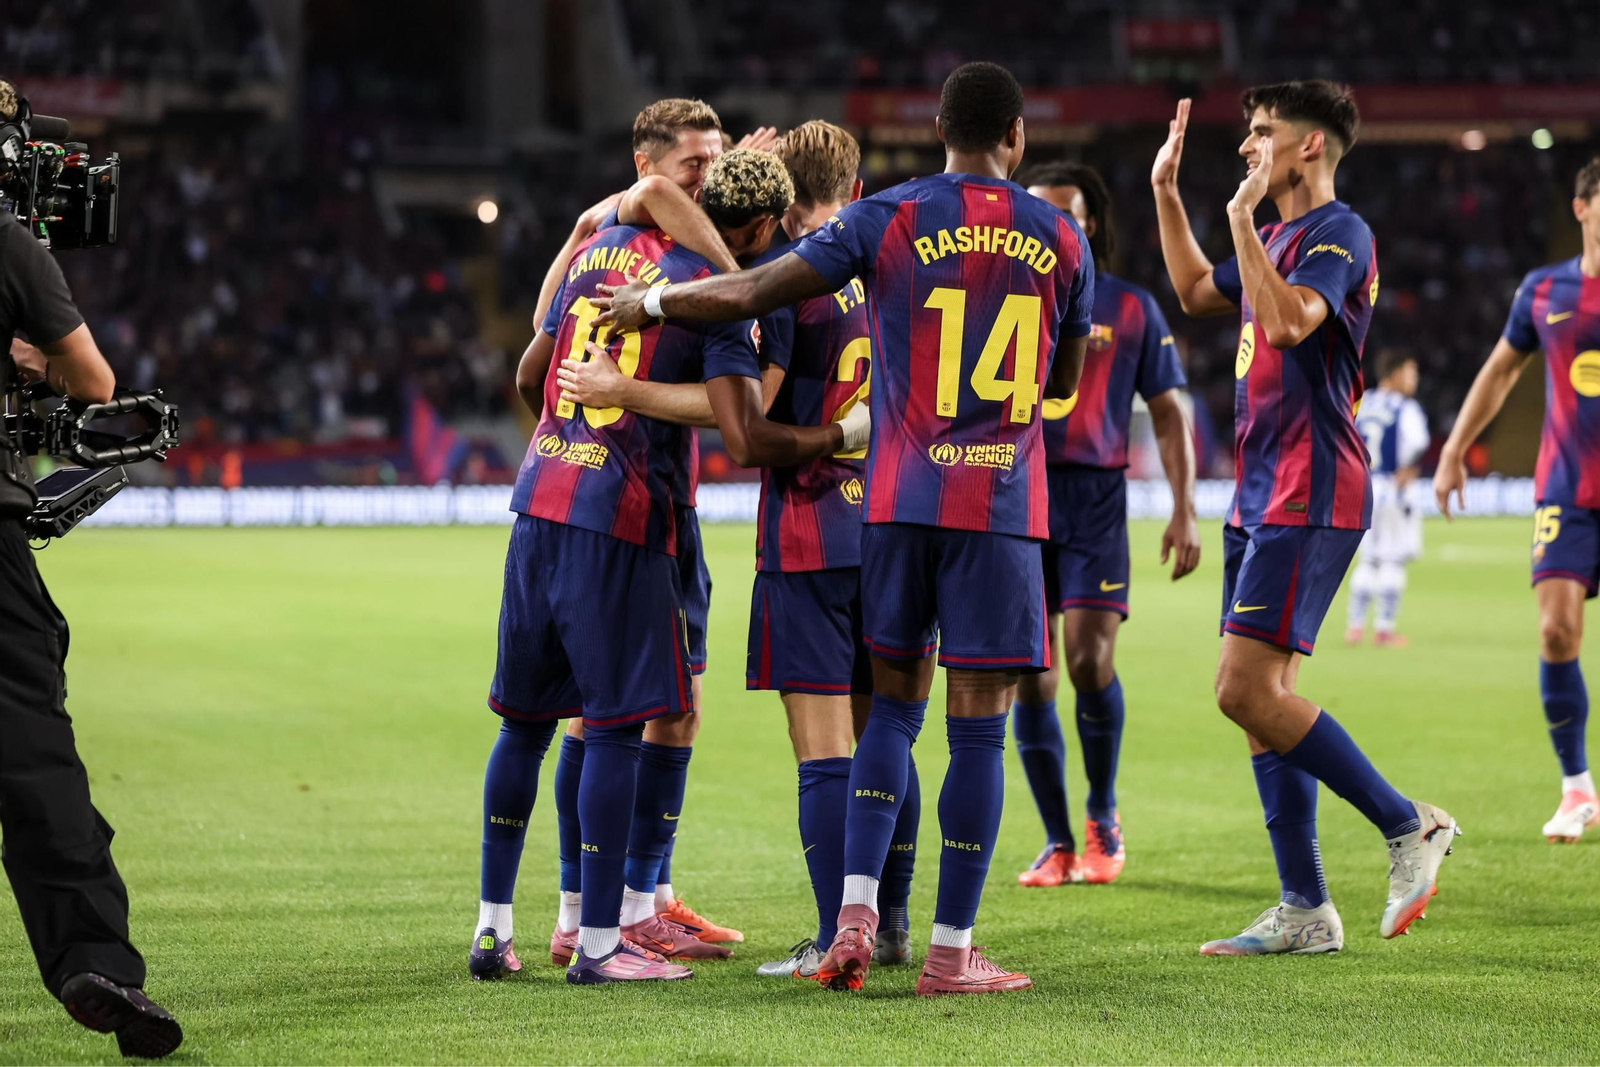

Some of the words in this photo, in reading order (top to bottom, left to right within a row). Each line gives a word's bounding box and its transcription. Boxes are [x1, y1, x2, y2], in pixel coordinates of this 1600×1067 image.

[914, 225, 1058, 275] RASHFORD
[569, 246, 642, 284] LAMINE
[556, 295, 642, 430] 10
[923, 287, 1042, 425] 14
[568, 442, 609, 458] UNHCR
[965, 443, 1016, 456] UNHCR
[561, 451, 606, 467] ACNUR
[963, 453, 1014, 467] ACNUR
[1533, 505, 1562, 544] 15
[855, 789, 896, 803] BARÇA
[490, 815, 525, 828] BARÇA
[944, 839, 982, 852] BARÇA
